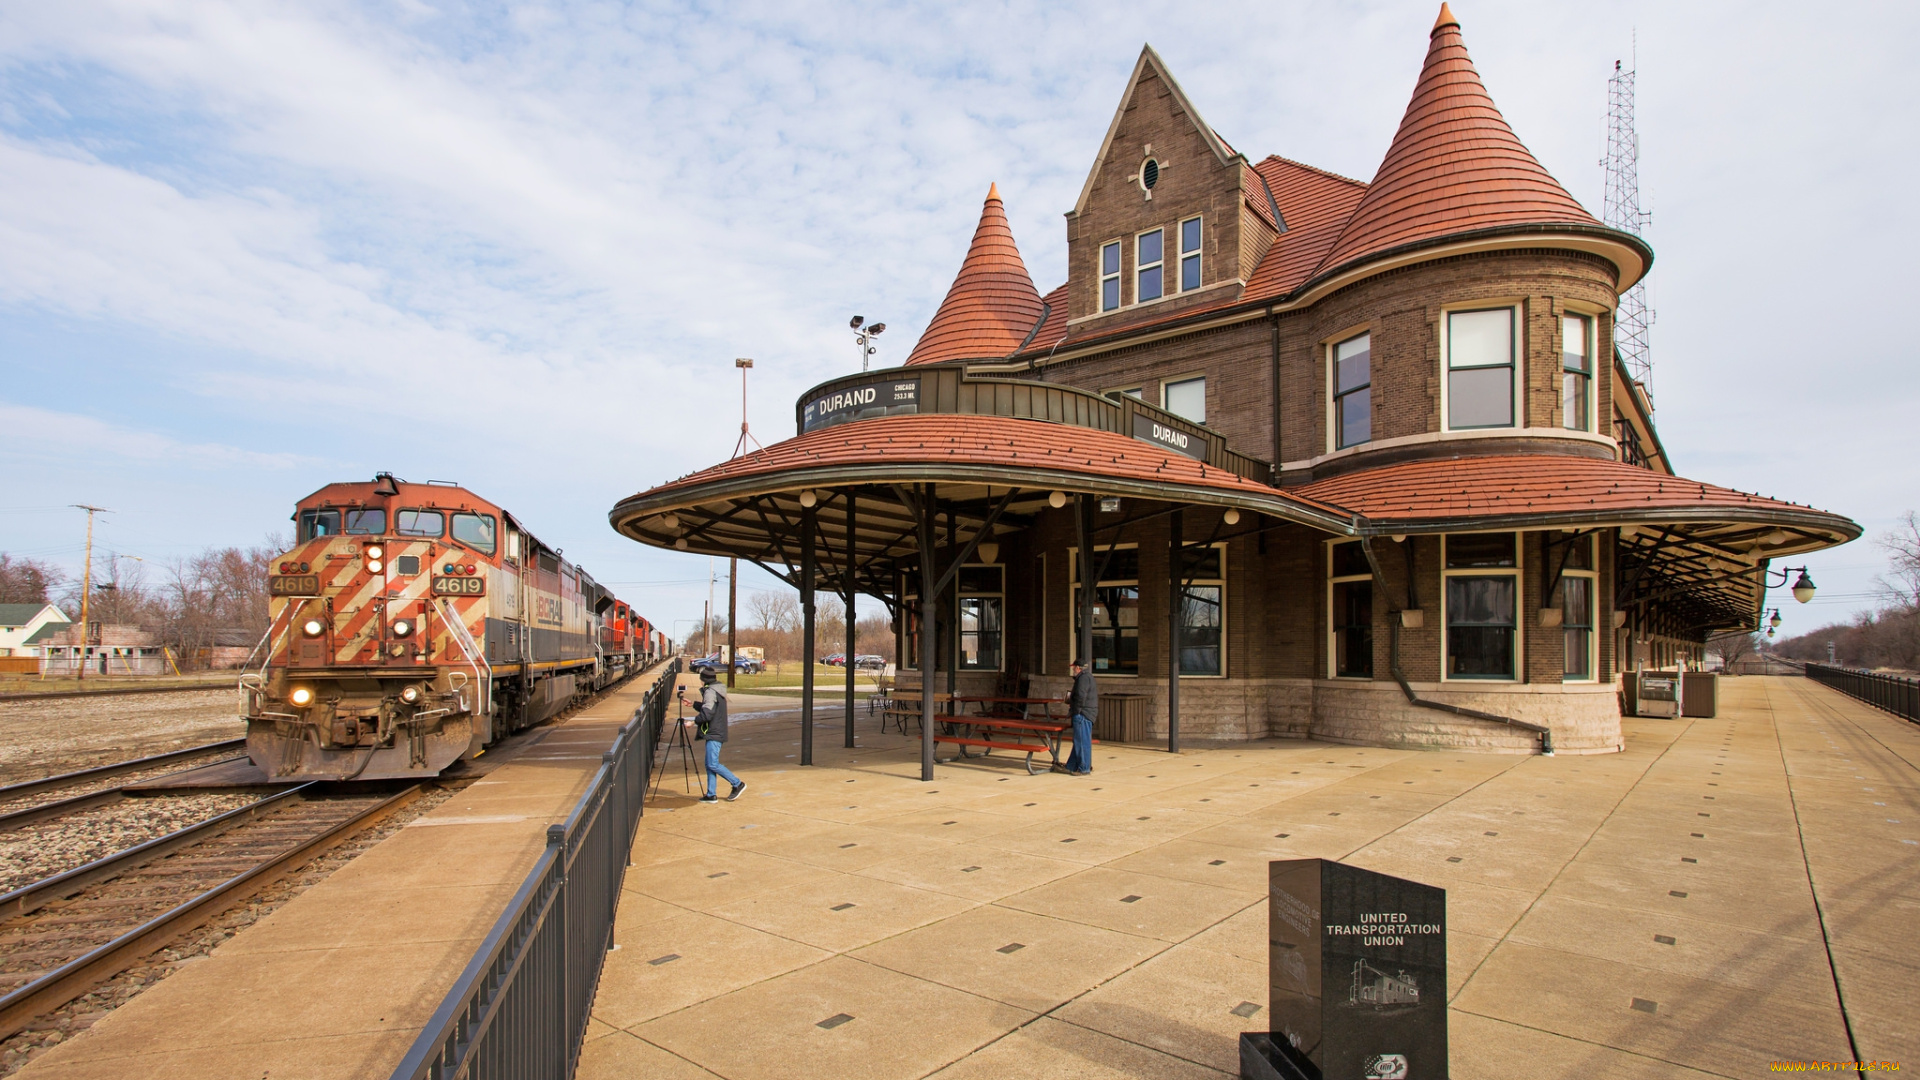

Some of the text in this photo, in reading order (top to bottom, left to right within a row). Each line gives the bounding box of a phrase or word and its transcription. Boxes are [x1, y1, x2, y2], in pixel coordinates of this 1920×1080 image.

[894, 383, 915, 392] CHICAGO
[820, 389, 876, 415] DURAND
[1153, 424, 1188, 448] DURAND
[274, 577, 315, 592] 4619
[435, 578, 481, 593] 4619
[1276, 898, 1312, 928] LOCOMOTIVE
[1360, 913, 1408, 924] UNITED
[1277, 909, 1311, 937] ENGINEERS
[1326, 924, 1441, 936] TRANSPORTATION
[1364, 936, 1405, 946] UNION
